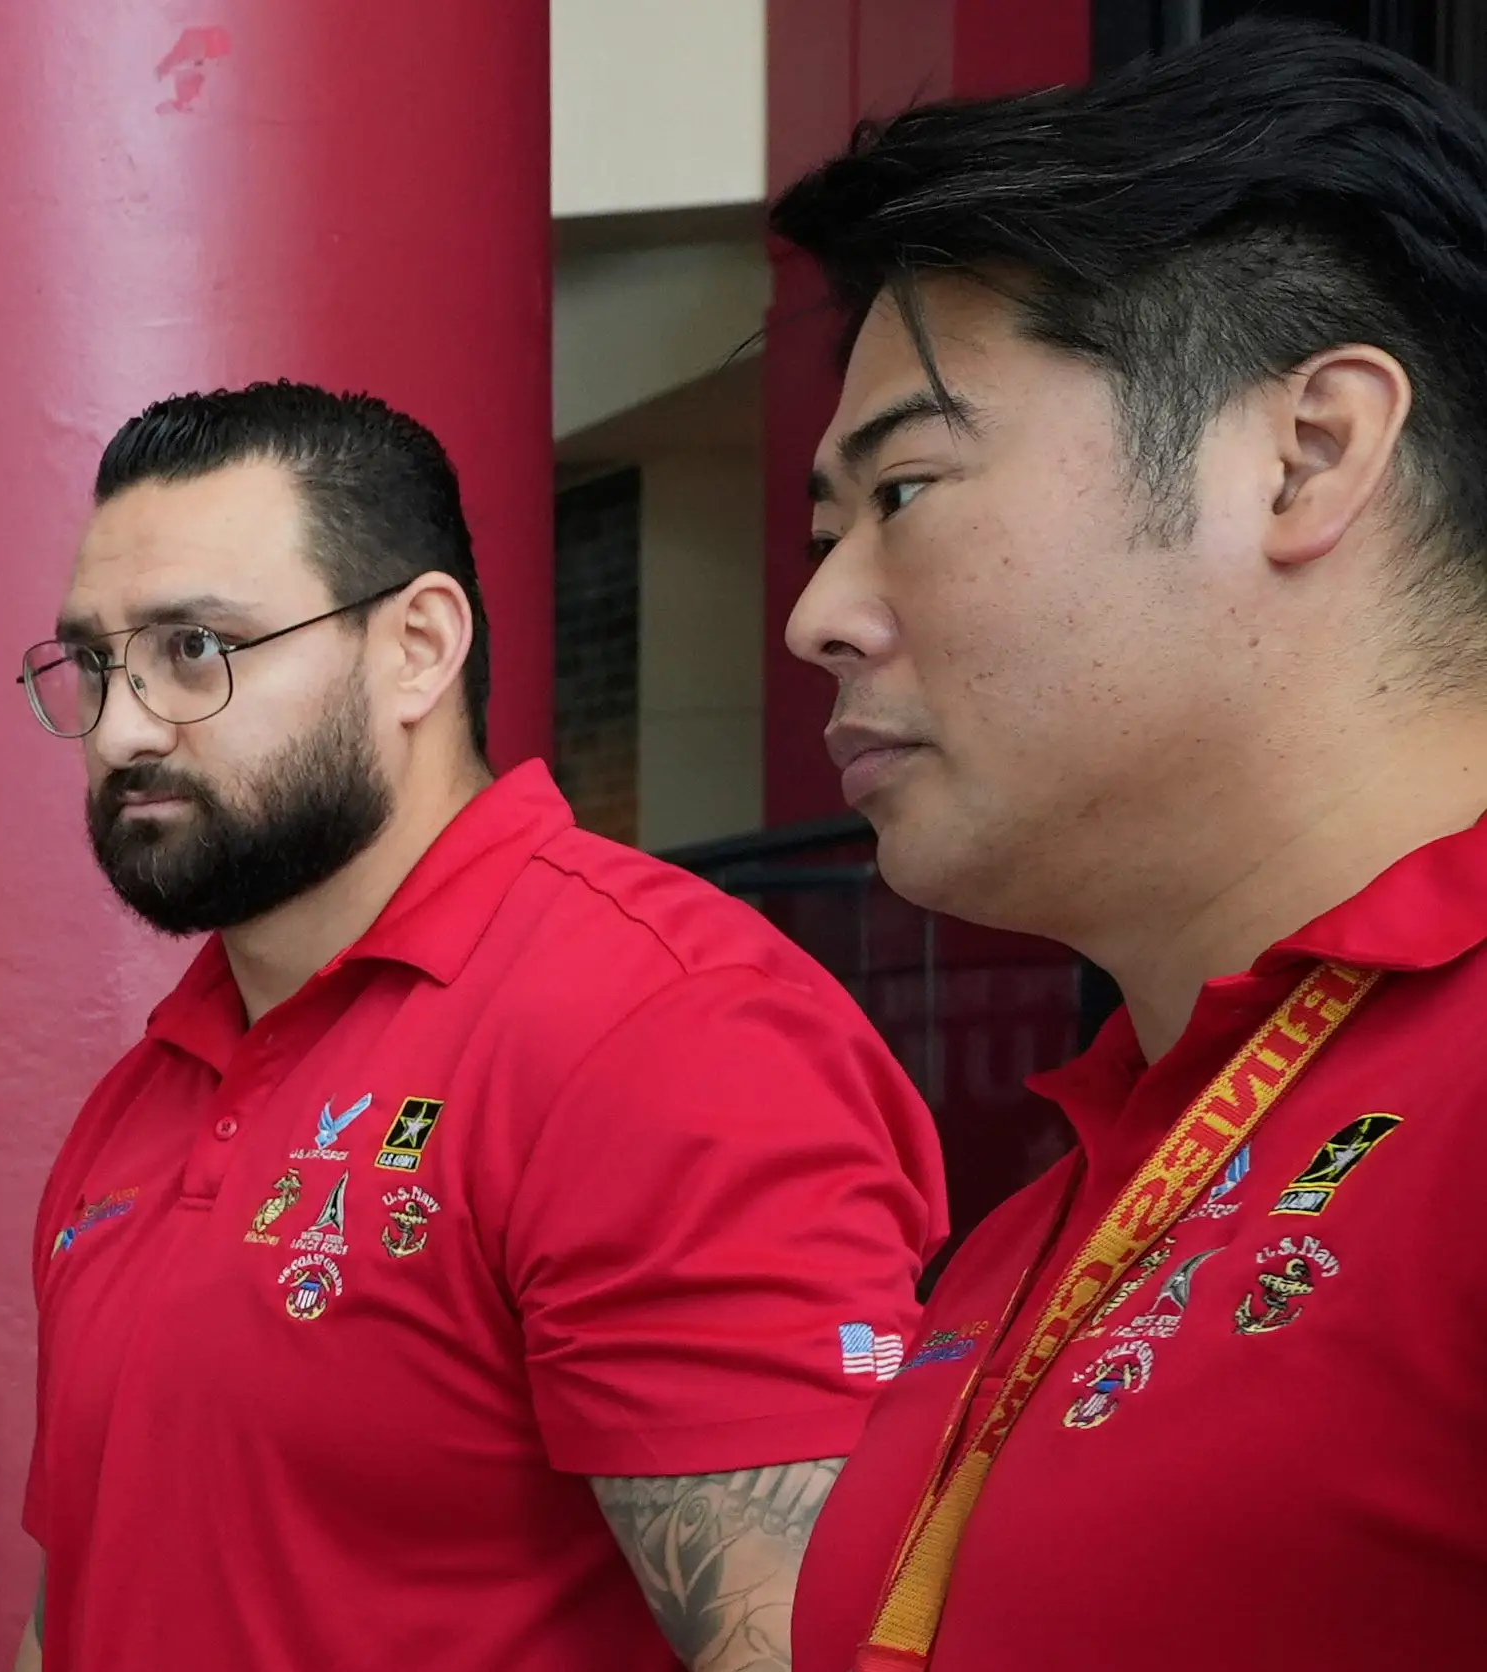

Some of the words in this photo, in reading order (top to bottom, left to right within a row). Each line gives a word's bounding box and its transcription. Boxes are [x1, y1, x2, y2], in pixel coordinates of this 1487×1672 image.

[379, 1152, 394, 1166] U.S.
[393, 1154, 417, 1169] ARMY
[381, 1185, 410, 1207] U.S.
[411, 1184, 442, 1214] Navy
[1255, 1238, 1296, 1264] U.S.
[1297, 1235, 1341, 1278] Navy
